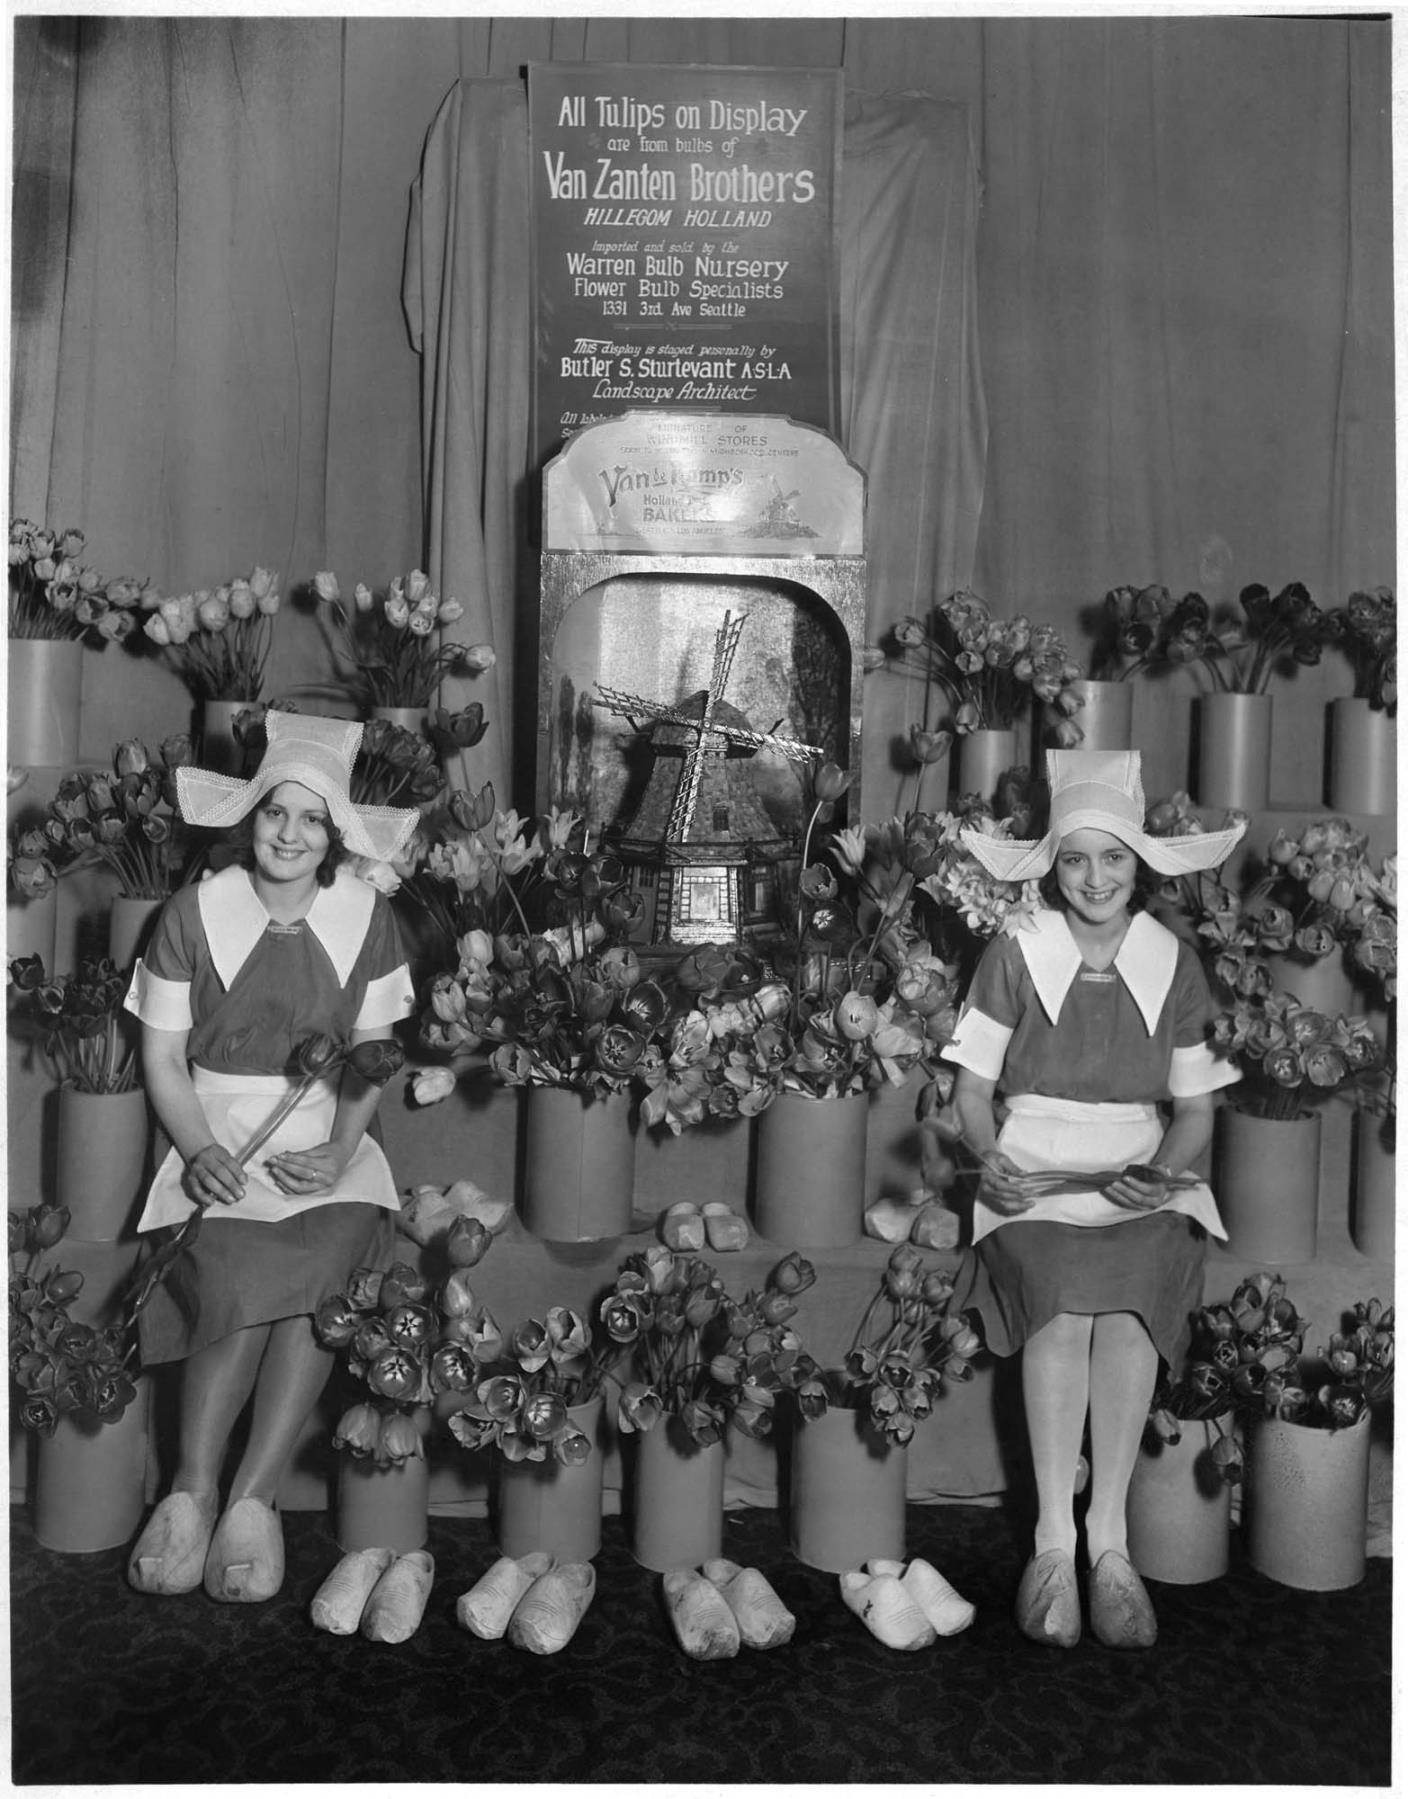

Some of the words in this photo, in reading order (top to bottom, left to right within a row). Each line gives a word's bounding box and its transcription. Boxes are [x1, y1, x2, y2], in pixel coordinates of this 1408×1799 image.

[558, 96, 586, 127] All
[595, 96, 665, 135] Tulips
[675, 104, 700, 129] on
[709, 100, 808, 137] Display
[607, 137, 630, 151] are
[640, 136, 668, 152] from
[675, 137, 713, 153] bulbs
[722, 137, 740, 158] of
[543, 150, 587, 200] Van
[592, 158, 676, 201] Zanten
[690, 163, 816, 204] Brothers
[583, 208, 673, 227] HILLEGOM
[683, 209, 772, 228] HOLLAND
[592, 240, 639, 255] Imported
[643, 240, 665, 253] and
[668, 241, 695, 253] sold
[702, 242, 716, 256] by
[721, 241, 740, 254] the
[566, 252, 636, 276] Warren
[645, 255, 684, 277] Bulb
[695, 256, 789, 281] Nursery
[574, 278, 627, 297] Flower
[638, 279, 680, 298] Bulb
[689, 280, 784, 300] Specialists
[602, 300, 628, 316] 1331
[671, 301, 692, 317] Ave
[700, 302, 746, 317] Seattle
[572, 338, 613, 355] This
[601, 344, 642, 358] display
[645, 344, 656, 355] is
[657, 344, 694, 358] staged
[698, 345, 755, 359] personally
[760, 344, 777, 359] by
[560, 357, 614, 378] Butler
[619, 357, 635, 378] S.
[637, 358, 737, 379] Sturtevant
[592, 378, 675, 403] Landscape
[675, 381, 758, 401] Architect
[734, 424, 748, 433] OF
[718, 435, 768, 447] STORES
[599, 465, 650, 508] Van
